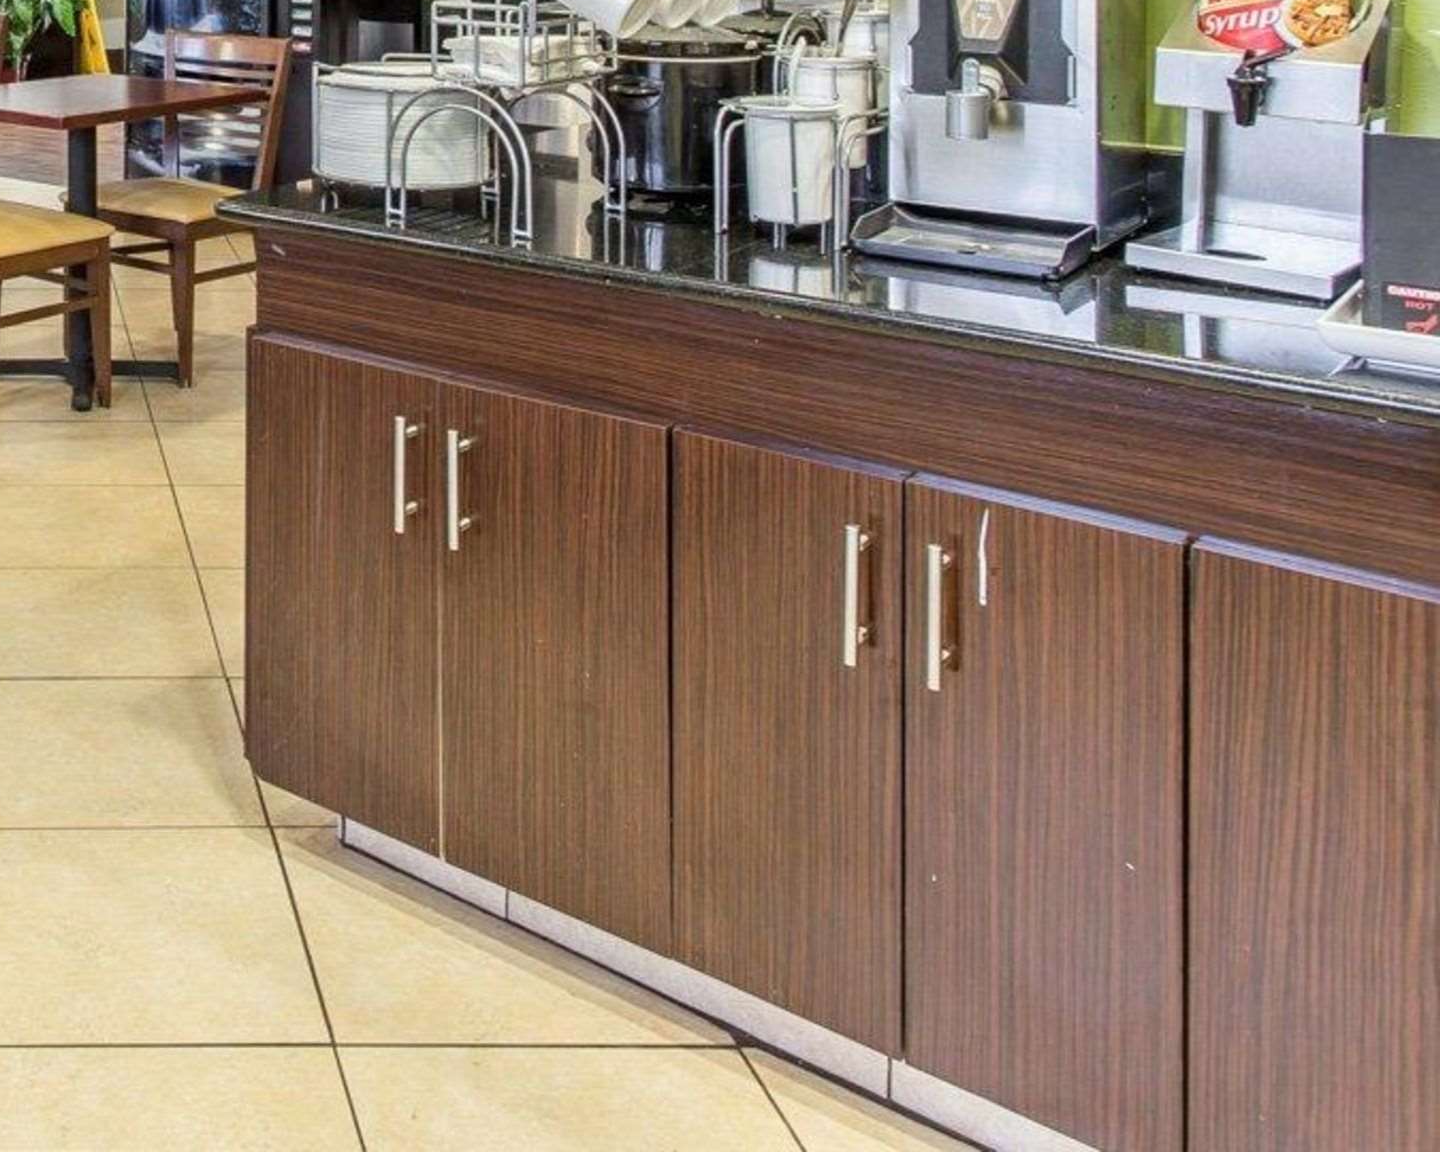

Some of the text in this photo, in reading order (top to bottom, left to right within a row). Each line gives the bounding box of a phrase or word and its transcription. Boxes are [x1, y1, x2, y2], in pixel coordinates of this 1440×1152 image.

[1204, 6, 1281, 36] Syrup
[1387, 284, 1440, 301] CAUTIO
[1405, 300, 1433, 311] HOT
